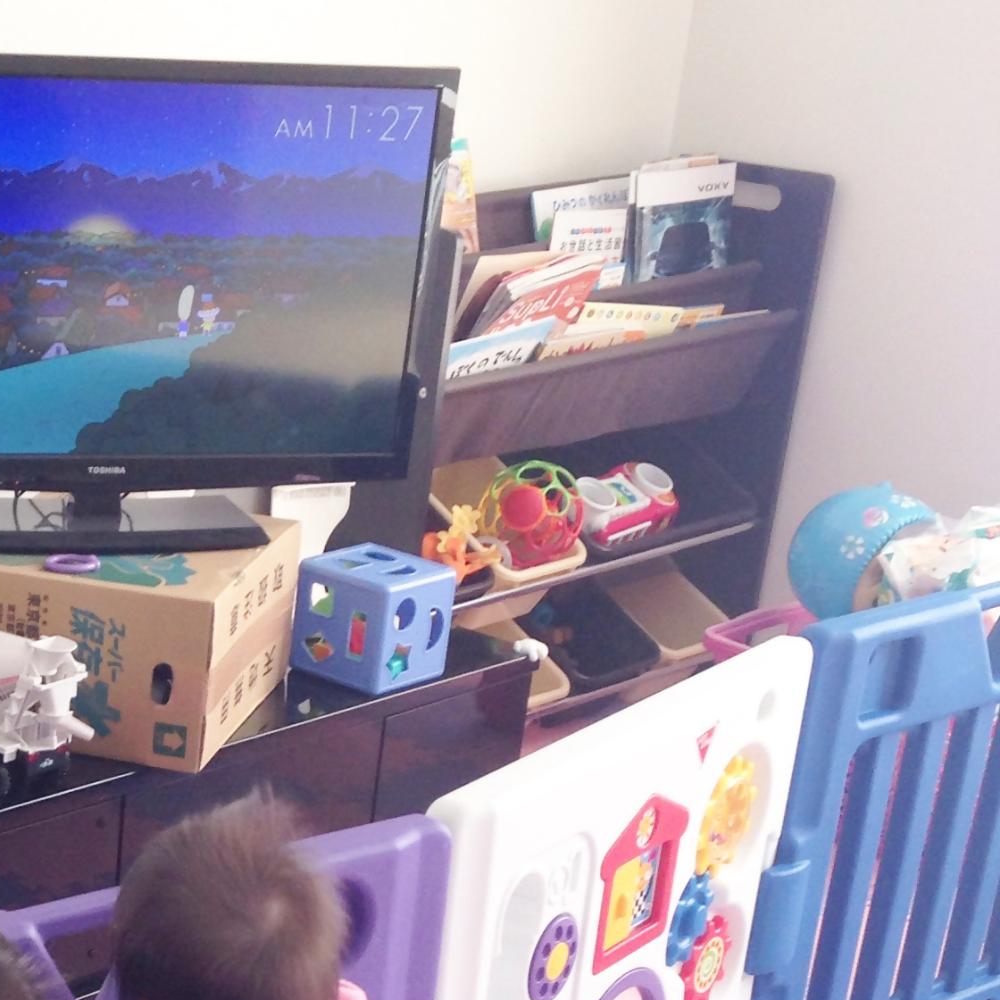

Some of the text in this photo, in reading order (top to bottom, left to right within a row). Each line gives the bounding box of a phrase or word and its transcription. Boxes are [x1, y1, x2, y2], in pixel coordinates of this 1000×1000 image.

[274, 104, 424, 142] AM 11:27
[87, 466, 126, 475] TOSHIBA
